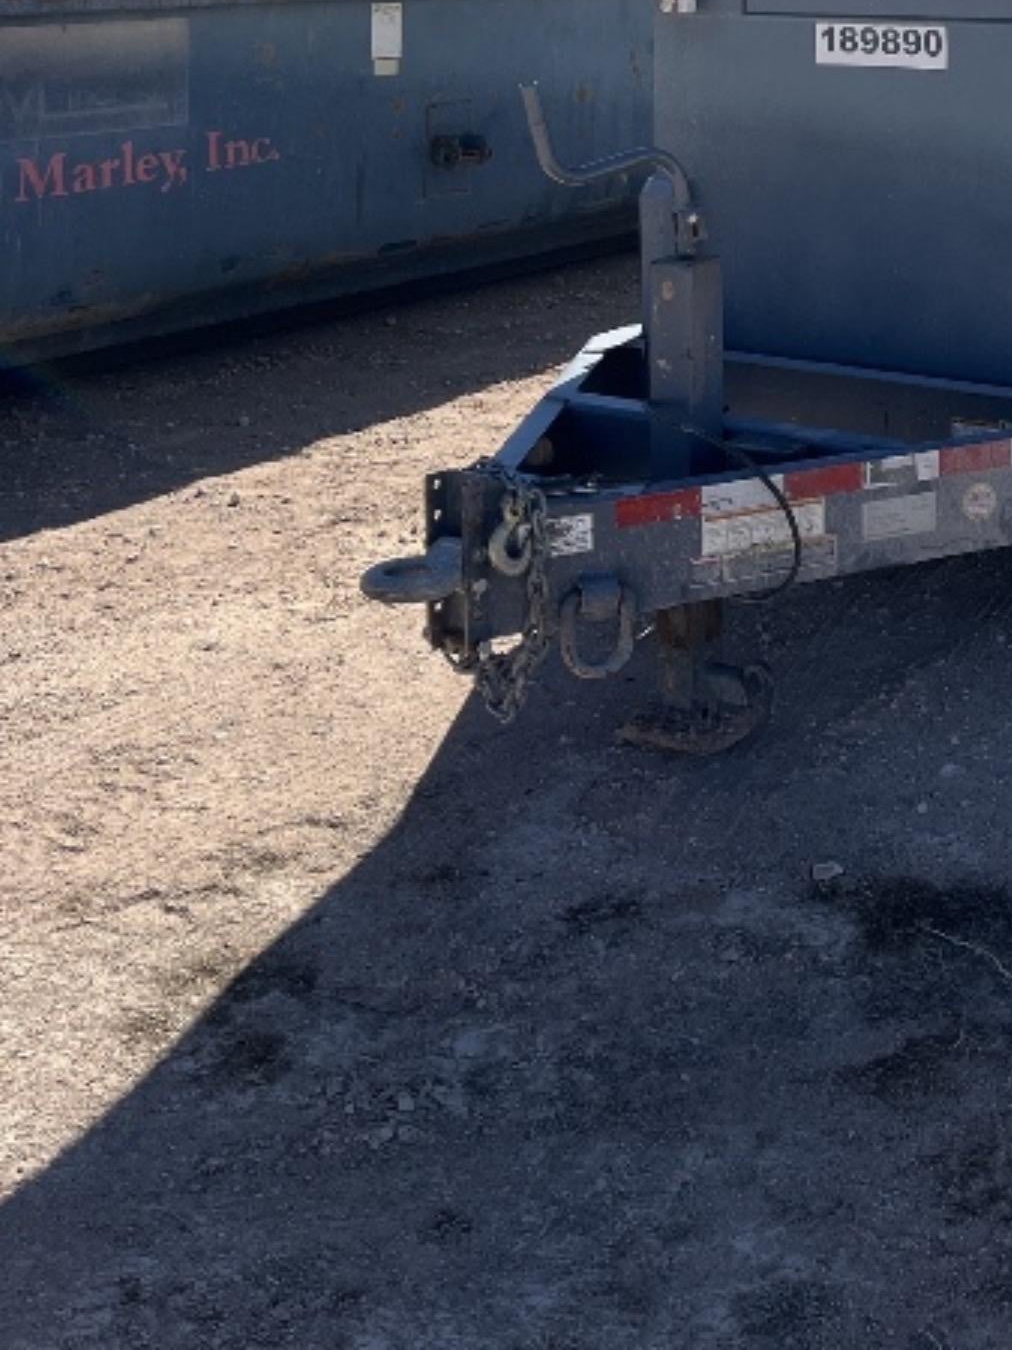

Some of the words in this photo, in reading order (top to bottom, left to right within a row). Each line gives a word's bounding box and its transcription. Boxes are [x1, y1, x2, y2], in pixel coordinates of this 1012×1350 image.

[820, 25, 944, 58] 189890
[15, 139, 188, 202] Marley,
[204, 130, 280, 173] Inc.
